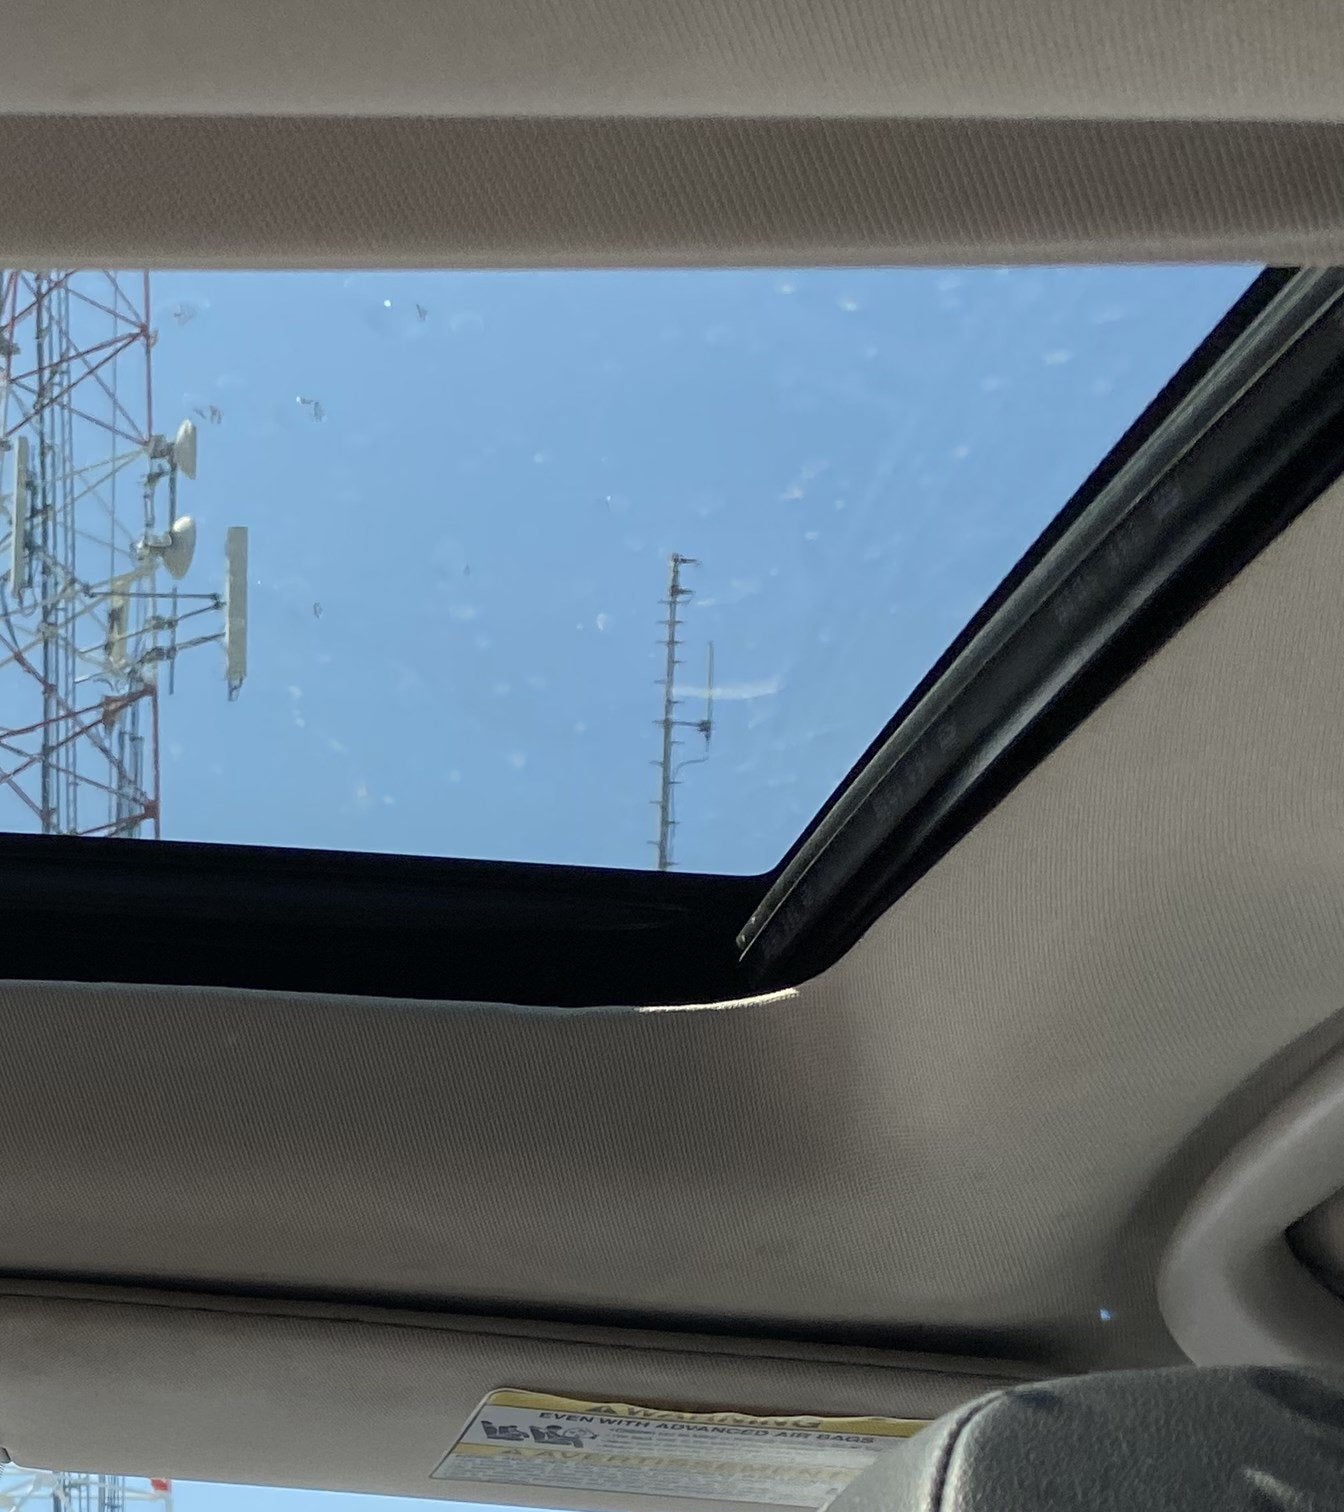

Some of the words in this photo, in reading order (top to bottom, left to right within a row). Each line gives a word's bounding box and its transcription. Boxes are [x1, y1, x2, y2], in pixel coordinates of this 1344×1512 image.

[539, 1411, 594, 1424] EVEN
[599, 1417, 651, 1429] WITH
[655, 1423, 769, 1437] ADVANCED
[775, 1430, 814, 1440] AIR
[816, 1434, 876, 1445] BAGS
